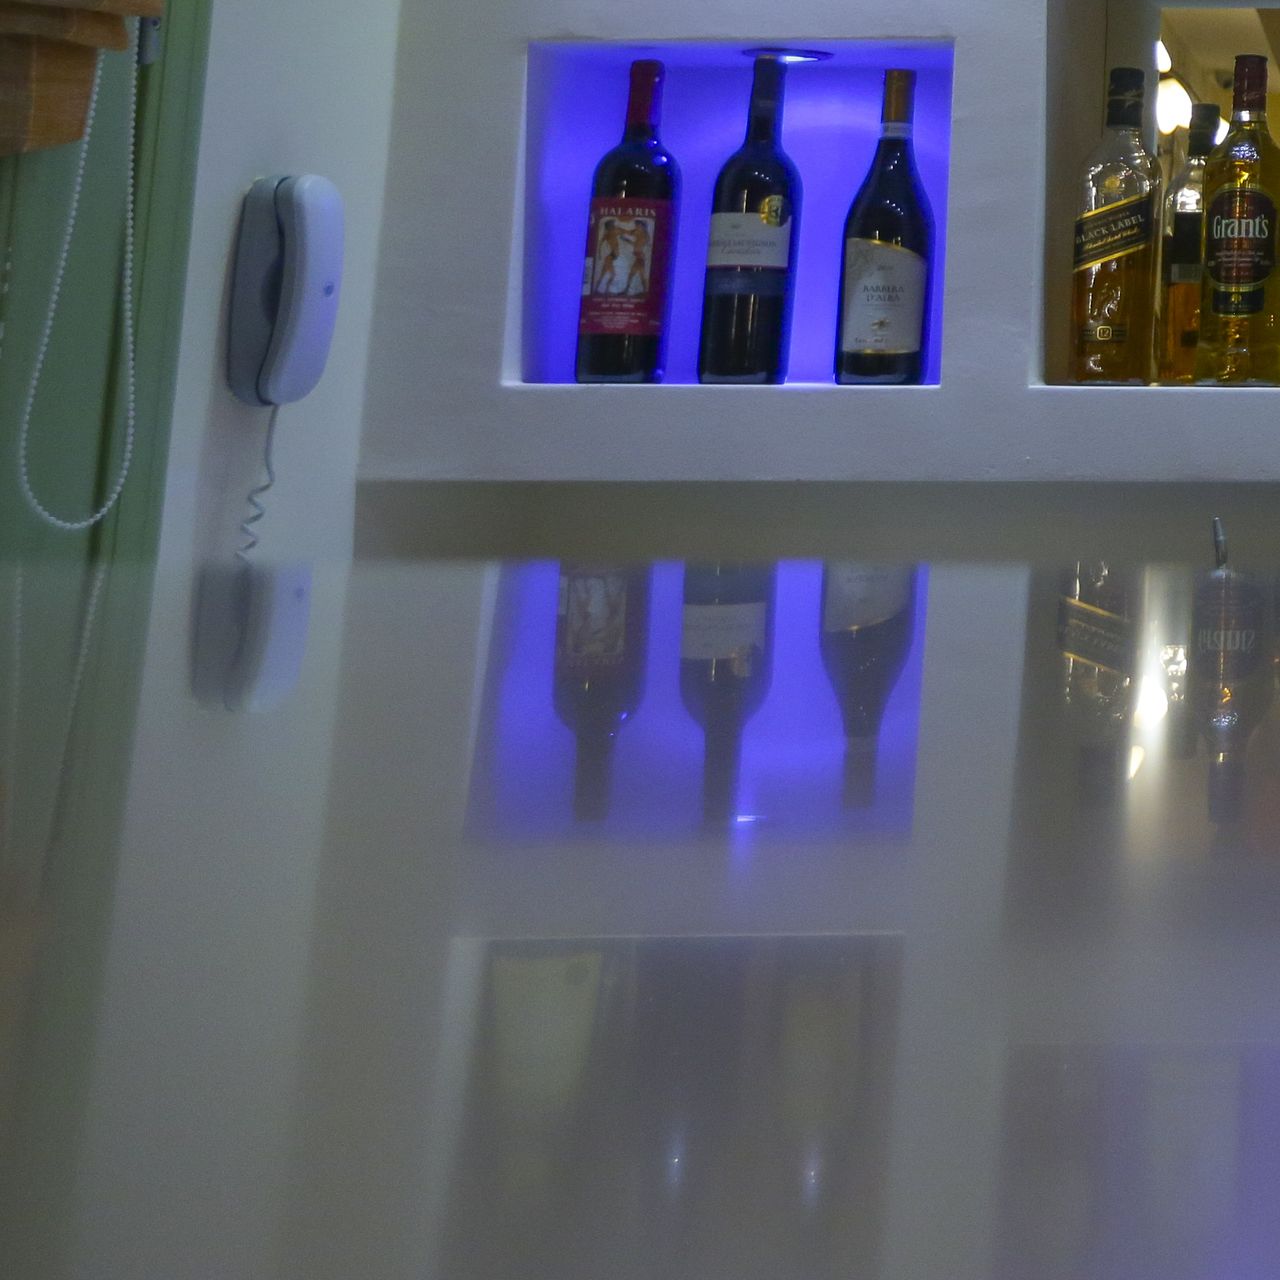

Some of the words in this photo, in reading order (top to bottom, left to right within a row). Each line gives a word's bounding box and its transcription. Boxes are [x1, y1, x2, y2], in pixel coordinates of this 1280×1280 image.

[1076, 226, 1108, 244] BLACK
[1110, 215, 1145, 233] LABEL
[1213, 213, 1269, 239] Grant's
